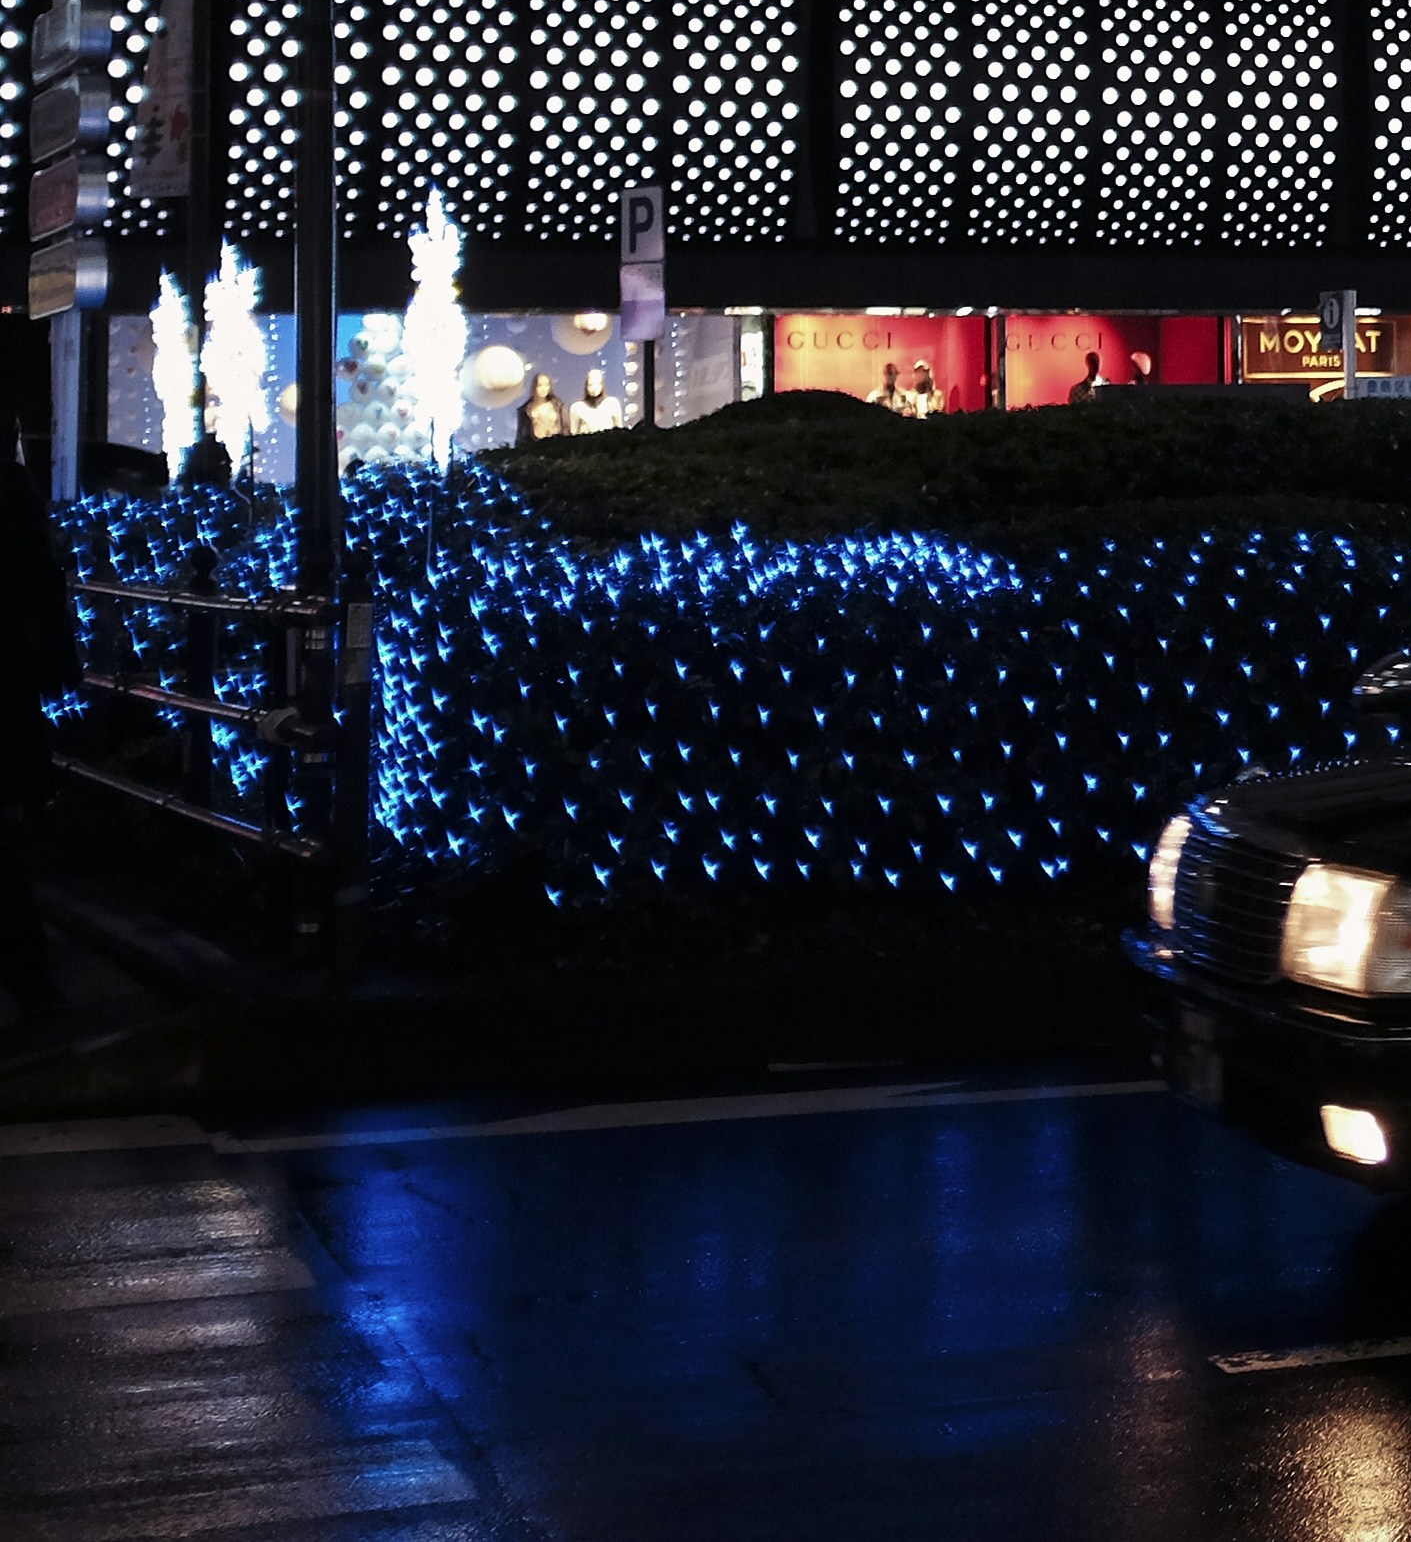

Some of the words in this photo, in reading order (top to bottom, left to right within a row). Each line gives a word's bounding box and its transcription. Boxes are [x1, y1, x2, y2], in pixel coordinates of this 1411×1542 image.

[629, 197, 655, 254] P
[787, 331, 892, 351] GUCCI
[1006, 331, 1102, 352] GUCCI
[1259, 329, 1382, 354] MOYAT
[1302, 355, 1342, 367] PARIS
